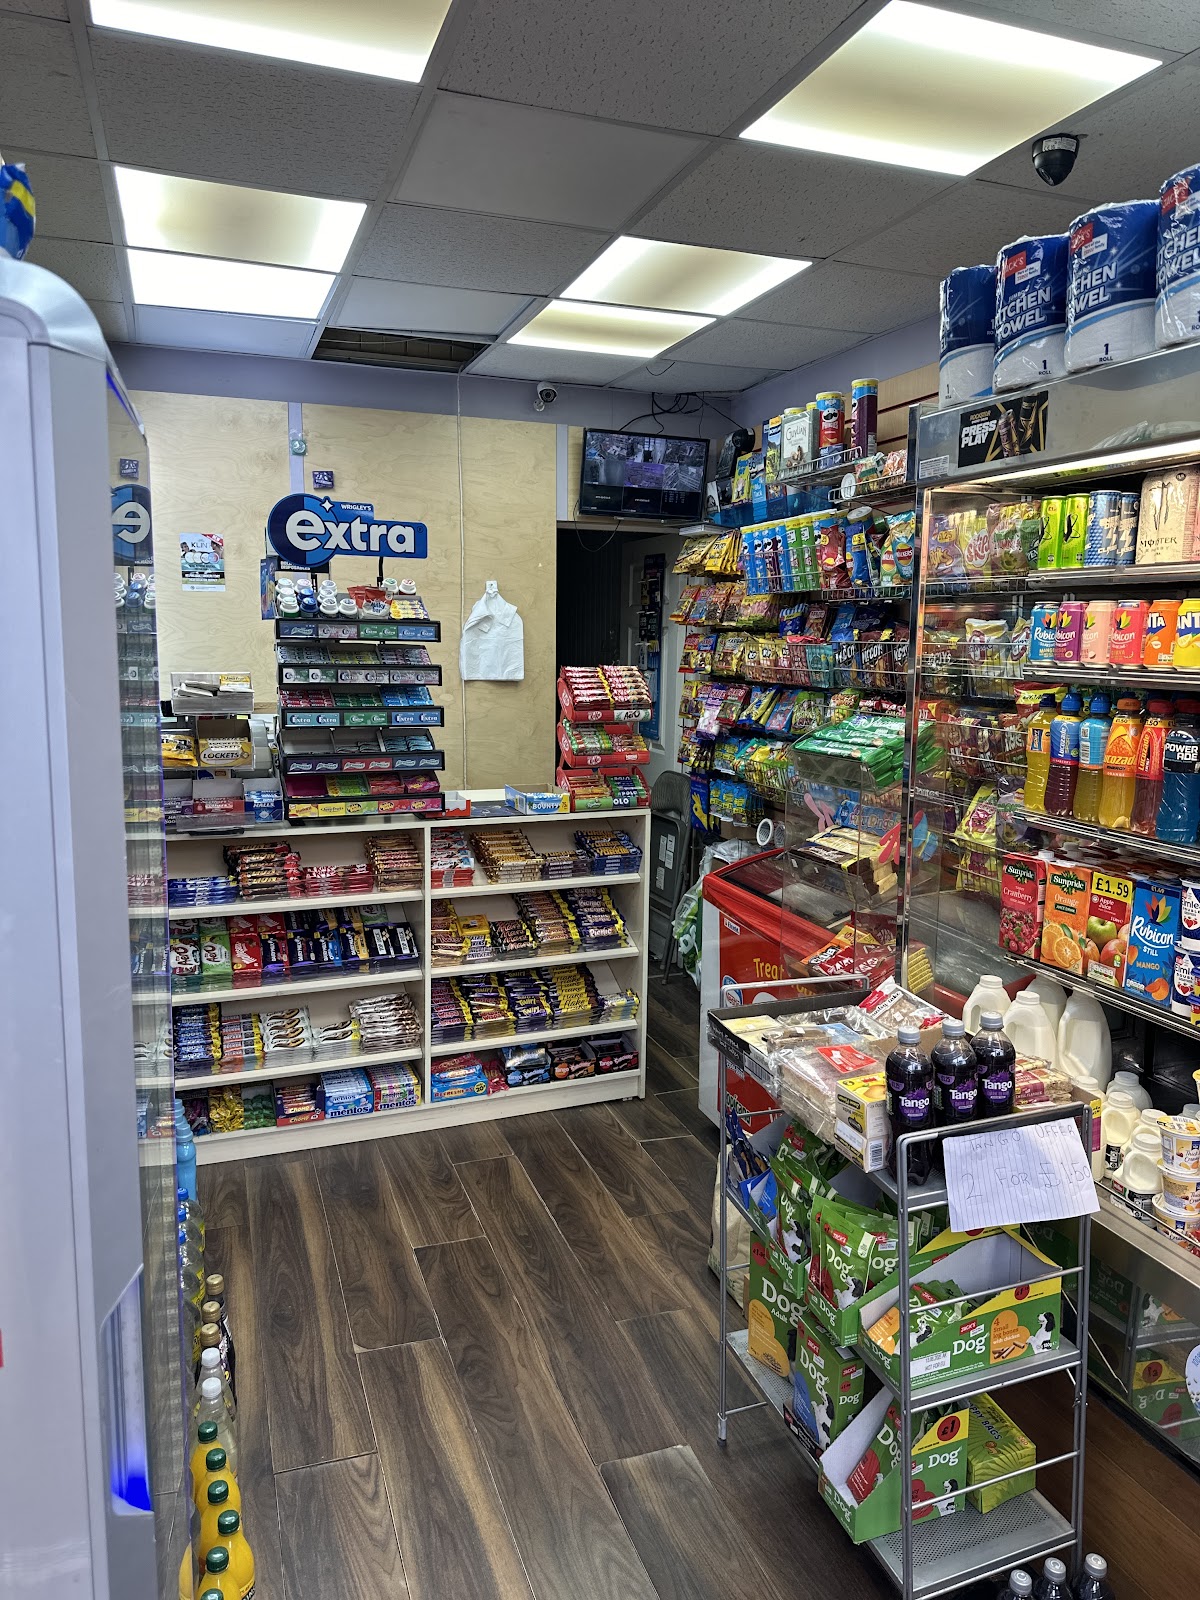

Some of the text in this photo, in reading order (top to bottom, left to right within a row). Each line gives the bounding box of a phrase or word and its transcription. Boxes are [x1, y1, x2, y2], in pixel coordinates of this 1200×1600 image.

[1103, 343, 1109, 355] 1
[1042, 359, 1047, 370] 1
[961, 419, 997, 438] PRESS
[961, 431, 988, 448] PLAY
[340, 503, 372, 511] WRIGLEY'S
[285, 509, 415, 554] extra
[1058, 727, 1067, 758] Lucozade
[1165, 742, 1199, 754] POWER
[1138, 734, 1150, 771] Lucozade
[1176, 751, 1198, 761] ADE
[532, 801, 561, 809] BOUNTY
[1006, 864, 1035, 879] Sunpride
[1053, 874, 1085, 890] Sunpride
[1095, 877, 1129, 898] £1.59
[1003, 885, 1034, 903] Cranberry
[1054, 892, 1080, 908] Orange
[1099, 897, 1114, 906] Apple
[1099, 902, 1112, 911] Juice
[588, 927, 612, 938] Picnic
[1131, 916, 1174, 945] Rubicon
[1142, 945, 1159, 957] STILL
[1136, 960, 1160, 970] MANGO
[982, 1079, 1013, 1091] Tango
[899, 1096, 930, 1109] Tango
[949, 1089, 977, 1101] Tango
[330, 1106, 369, 1117] mentos
[379, 1099, 416, 1110] mentos
[963, 1124, 1076, 1151] TANGO OFFER
[962, 1173, 983, 1200] 2
[994, 1166, 1031, 1187] FOR
[780, 1253, 794, 1280] Dog
[826, 1243, 854, 1283] Dog
[872, 1256, 899, 1277] og
[762, 1277, 808, 1328] Dog
[771, 1308, 788, 1324] Adult
[820, 1297, 837, 1327] Dog
[993, 1317, 1000, 1326] 4
[993, 1323, 1009, 1332] Small
[1002, 1327, 1019, 1336] bones
[1003, 1333, 1021, 1343] chicken
[952, 1332, 990, 1355] Dog
[871, 1341, 893, 1370] Dog
[800, 1345, 830, 1396] Dog
[839, 1392, 862, 1406] Dog
[941, 1419, 956, 1436] £1
[982, 1420, 1003, 1441] BAGS
[928, 1446, 963, 1469] Dog
